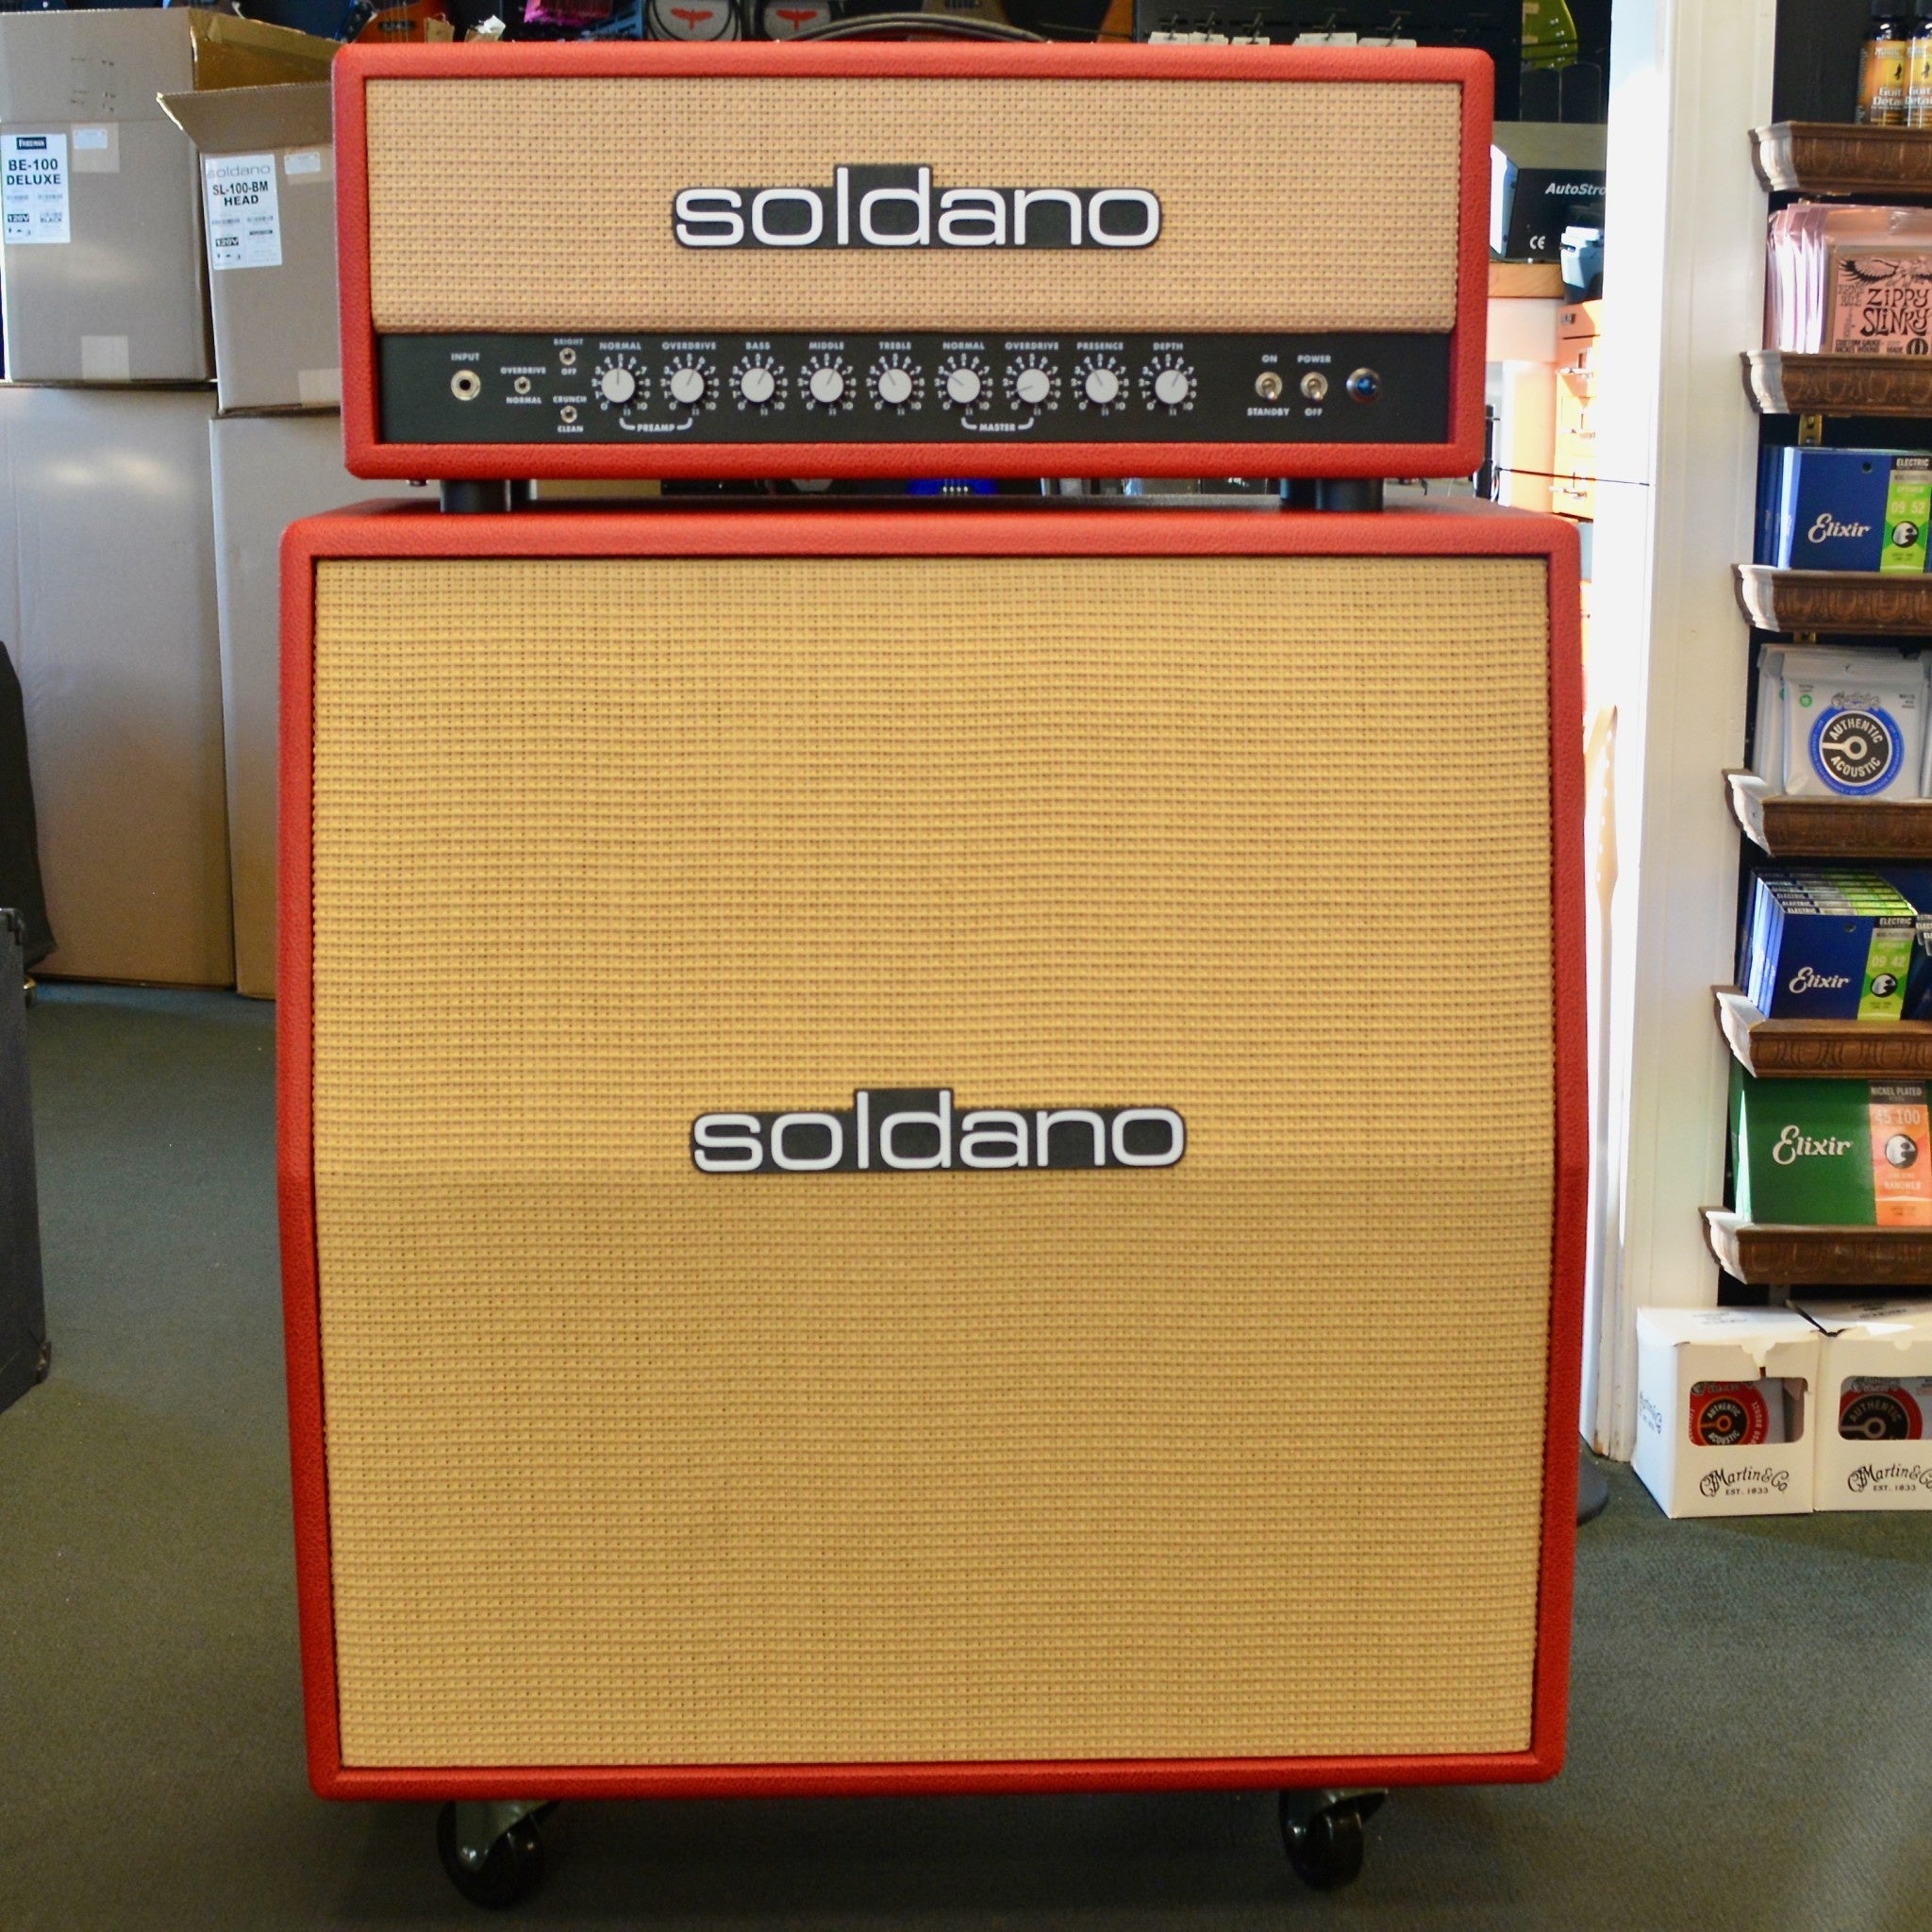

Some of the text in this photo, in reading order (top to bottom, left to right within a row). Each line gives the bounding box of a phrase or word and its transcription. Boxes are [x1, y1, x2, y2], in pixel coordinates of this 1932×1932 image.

[8, 158, 58, 171] BE-100
[7, 175, 61, 186] DELUXE
[212, 180, 269, 195] SL-100-BM
[225, 194, 259, 207] HEAD
[675, 167, 1159, 246] soldano
[8, 214, 29, 223] 120V
[216, 237, 239, 247] 120V
[553, 338, 584, 346] BRIGHT
[599, 341, 641, 351] NORMAL
[661, 341, 717, 351] OVERDRIVE
[745, 341, 771, 350] BASS
[808, 341, 845, 350] MIDDLE
[879, 341, 912, 350] TREBLE
[942, 341, 985, 350] NORMAL
[1005, 341, 1059, 350] OVERDRIVE
[1076, 341, 1124, 351] PRESENCE
[1153, 341, 1184, 351] DEPTH
[451, 352, 480, 361] INPUT
[1261, 355, 1278, 363] ON
[1297, 355, 1332, 363] POWER
[500, 366, 547, 375] OVERDRIVE
[1246, 408, 1290, 416] STANDBY
[1305, 408, 1323, 417] OFF
[979, 424, 1016, 432] MASTER
[1896, 458, 1929, 467] ELECTRIC
[1911, 501, 1925, 514] 52
[1807, 513, 1871, 543] Elixir
[1829, 718, 1883, 743] AUTHENTIC
[1831, 756, 1881, 777] ACOUSTIC
[1789, 966, 1851, 993] Elixir
[1871, 1087, 1922, 1096] NICKEL PLATED
[1897, 1109, 1921, 1124] 100
[693, 1090, 1185, 1173] soldano
[1772, 1124, 1852, 1165] Elixir
[1707, 1402, 1741, 1419] AUTHENTIC
[1850, 1399, 1902, 1423] AUTHENTIC
[1707, 1429, 1740, 1445] ACOUSTIC
